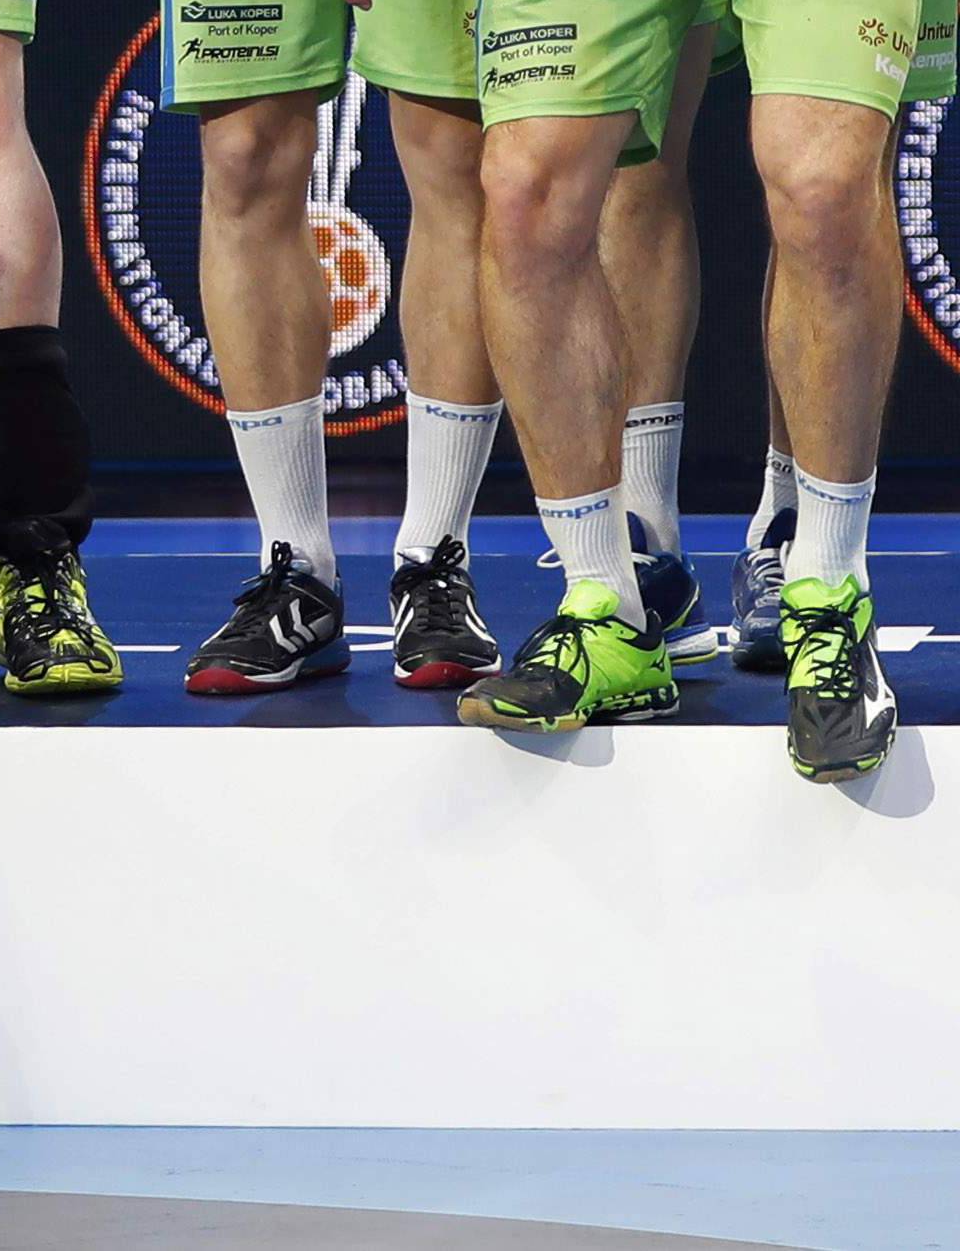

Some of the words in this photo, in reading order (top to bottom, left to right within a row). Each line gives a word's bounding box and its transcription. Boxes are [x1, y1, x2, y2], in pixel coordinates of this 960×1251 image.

[208, 9, 237, 20] LUKA
[240, 8, 279, 18] KOPER
[208, 24, 231, 36] Port
[232, 23, 244, 35] of
[246, 24, 279, 37] Koper
[500, 32, 527, 46] LUKA
[530, 27, 574, 40] KOPER
[500, 50, 521, 63] Port
[522, 46, 534, 58] of
[537, 42, 574, 56] Koper
[625, 413, 683, 429] empa
[540, 498, 610, 520] empa
